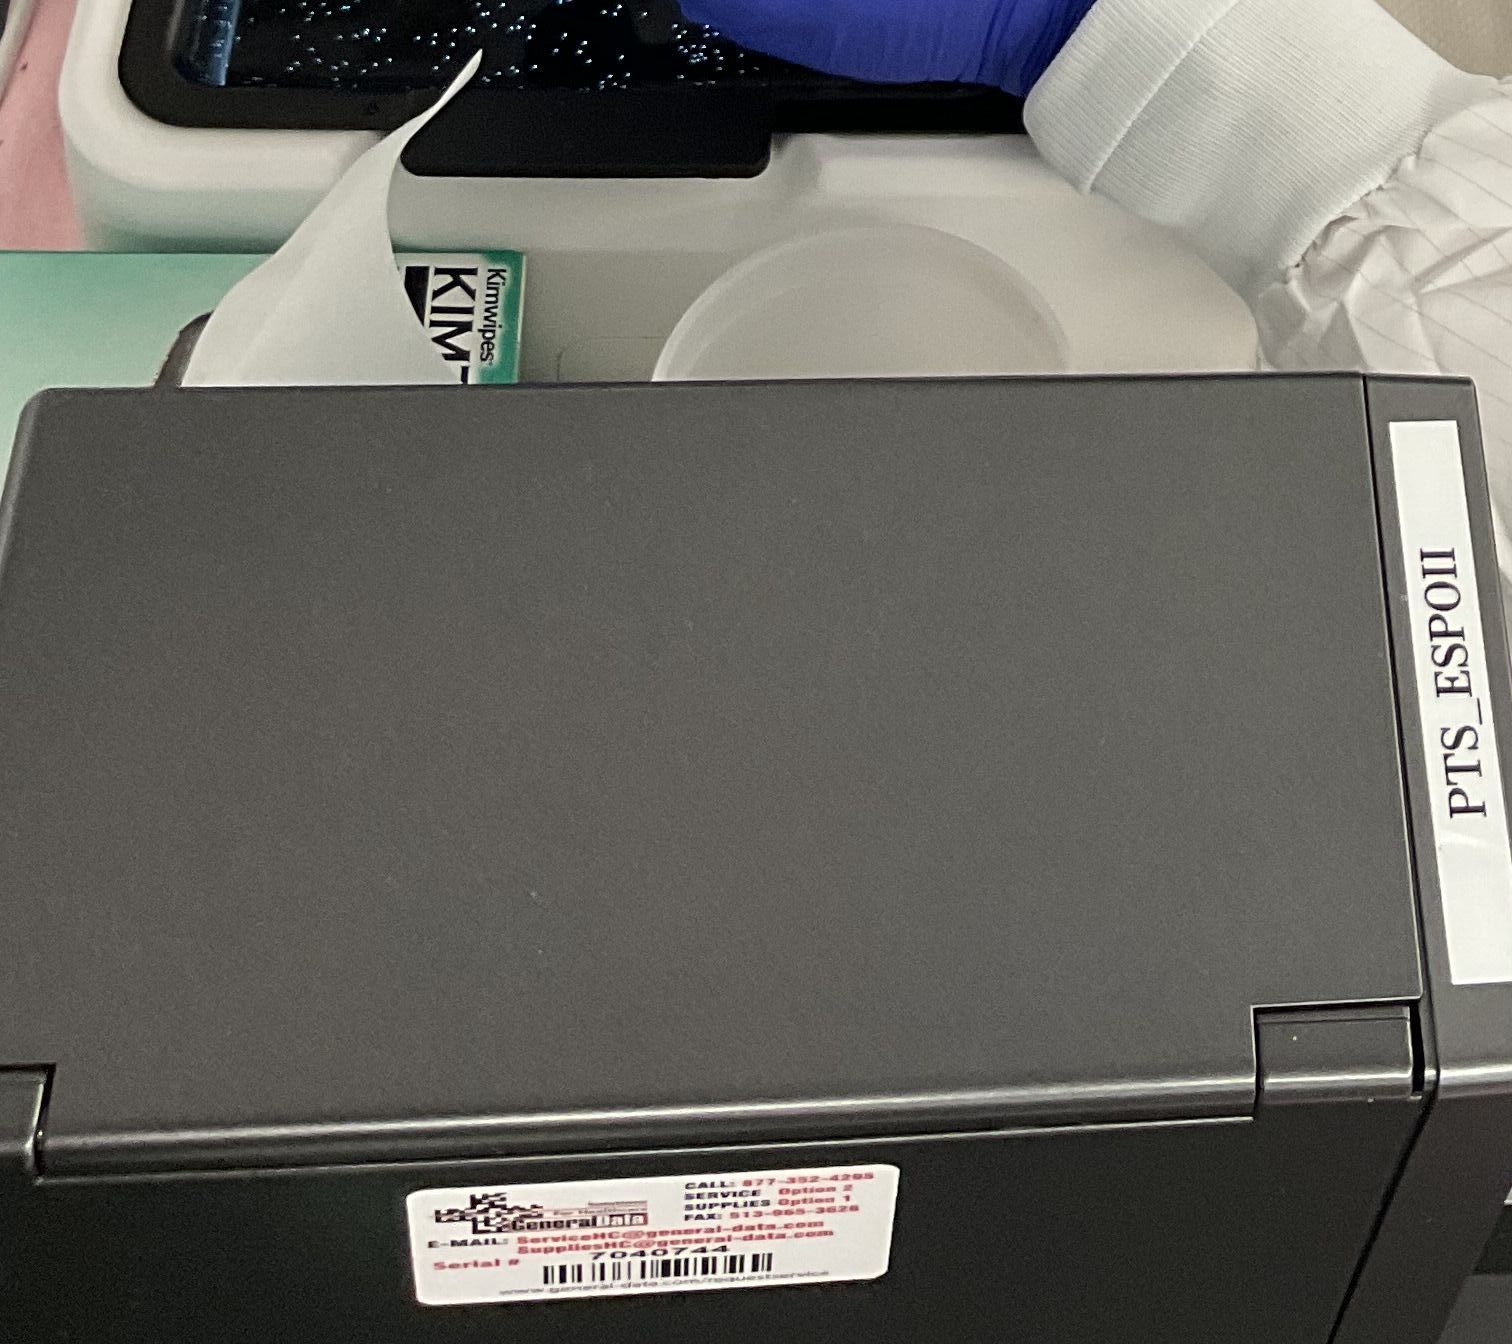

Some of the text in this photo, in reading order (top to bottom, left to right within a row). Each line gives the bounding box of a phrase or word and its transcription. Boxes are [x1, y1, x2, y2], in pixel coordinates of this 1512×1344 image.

[478, 268, 507, 363] Kimwipes
[684, 1189, 761, 1200] SERVICE
[684, 1199, 771, 1211] SUPPLIES
[590, 1245, 729, 1259] 7040744
[433, 1258, 501, 1270] Serial
